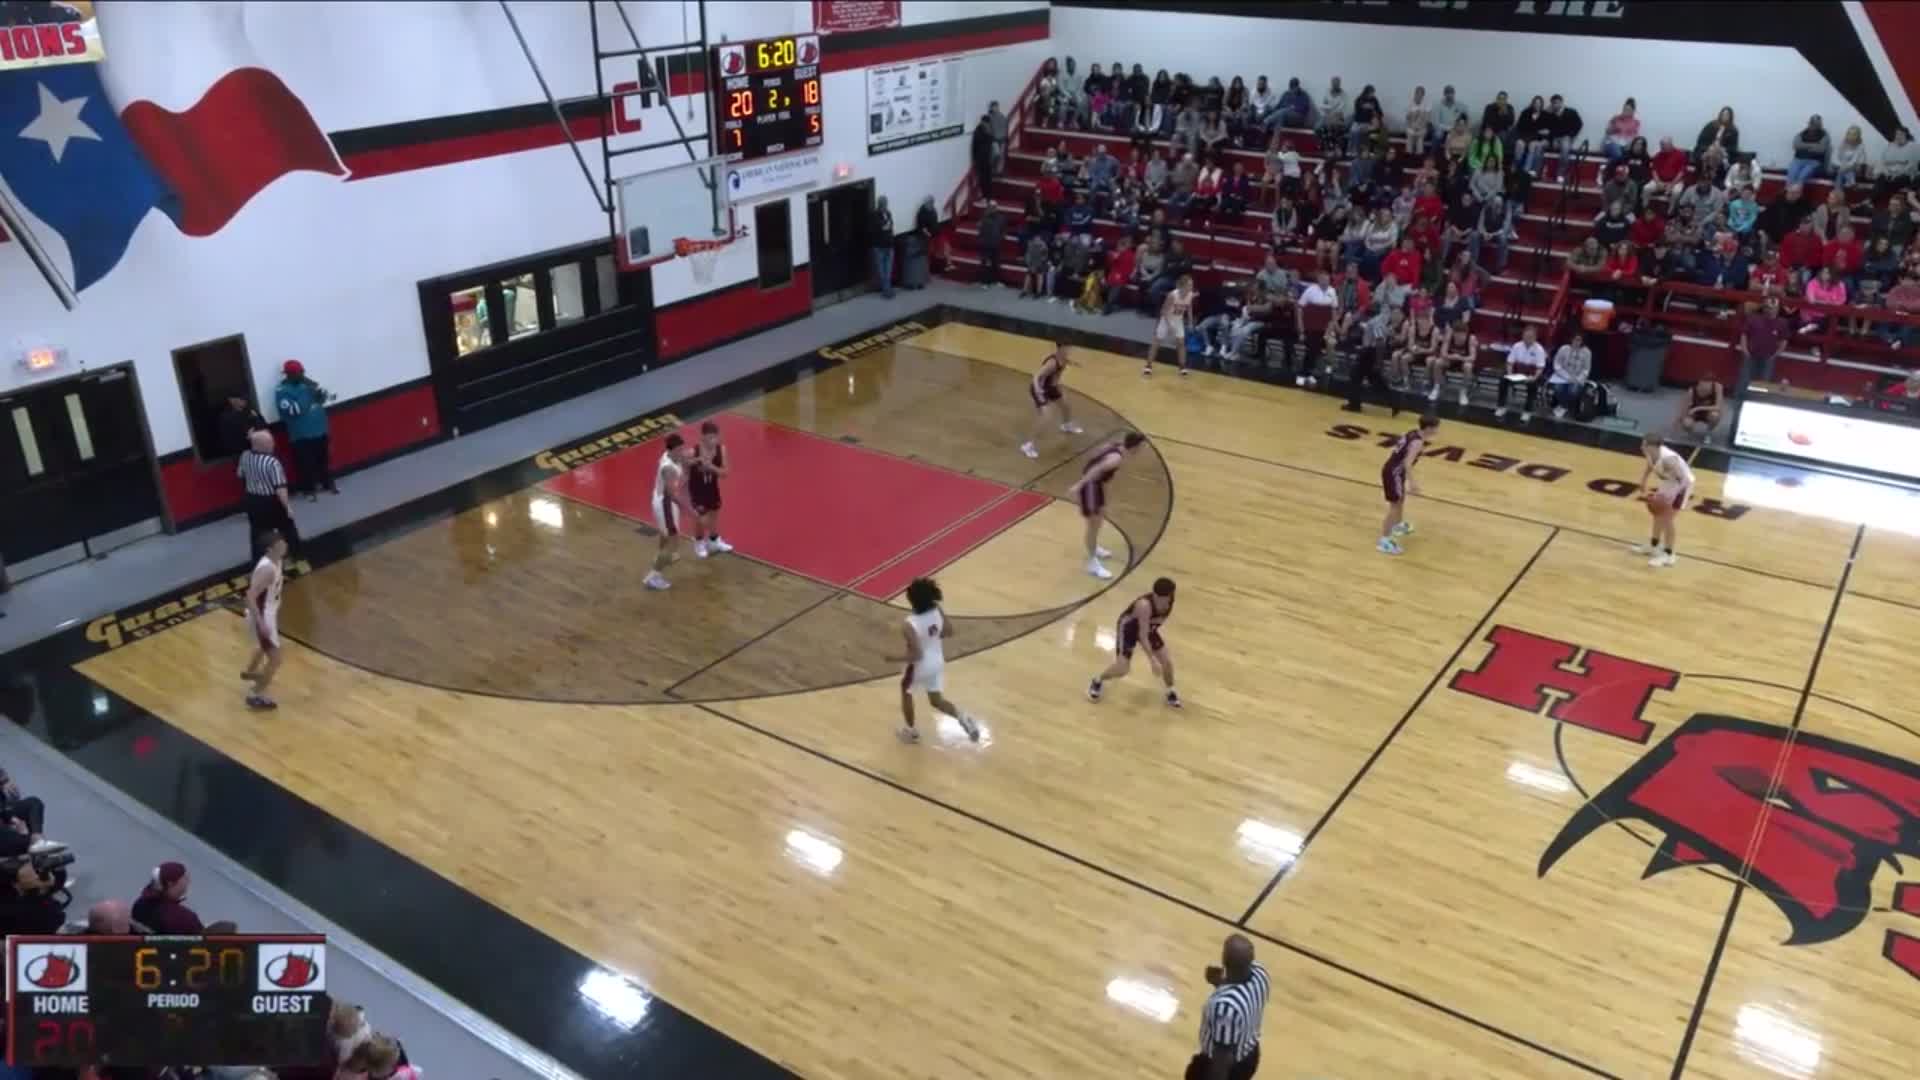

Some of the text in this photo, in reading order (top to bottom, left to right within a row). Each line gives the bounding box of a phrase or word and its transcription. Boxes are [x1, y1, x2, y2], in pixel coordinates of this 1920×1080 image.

[758, 40, 795, 68] 6:20
[731, 91, 753, 117] 20
[769, 89, 777, 109] 2
[804, 80, 818, 104] 18
[811, 114, 820, 133] 5
[535, 413, 684, 472] Guaranty
[1324, 424, 1751, 520] RD DEVLS
[1448, 624, 1681, 745] H
